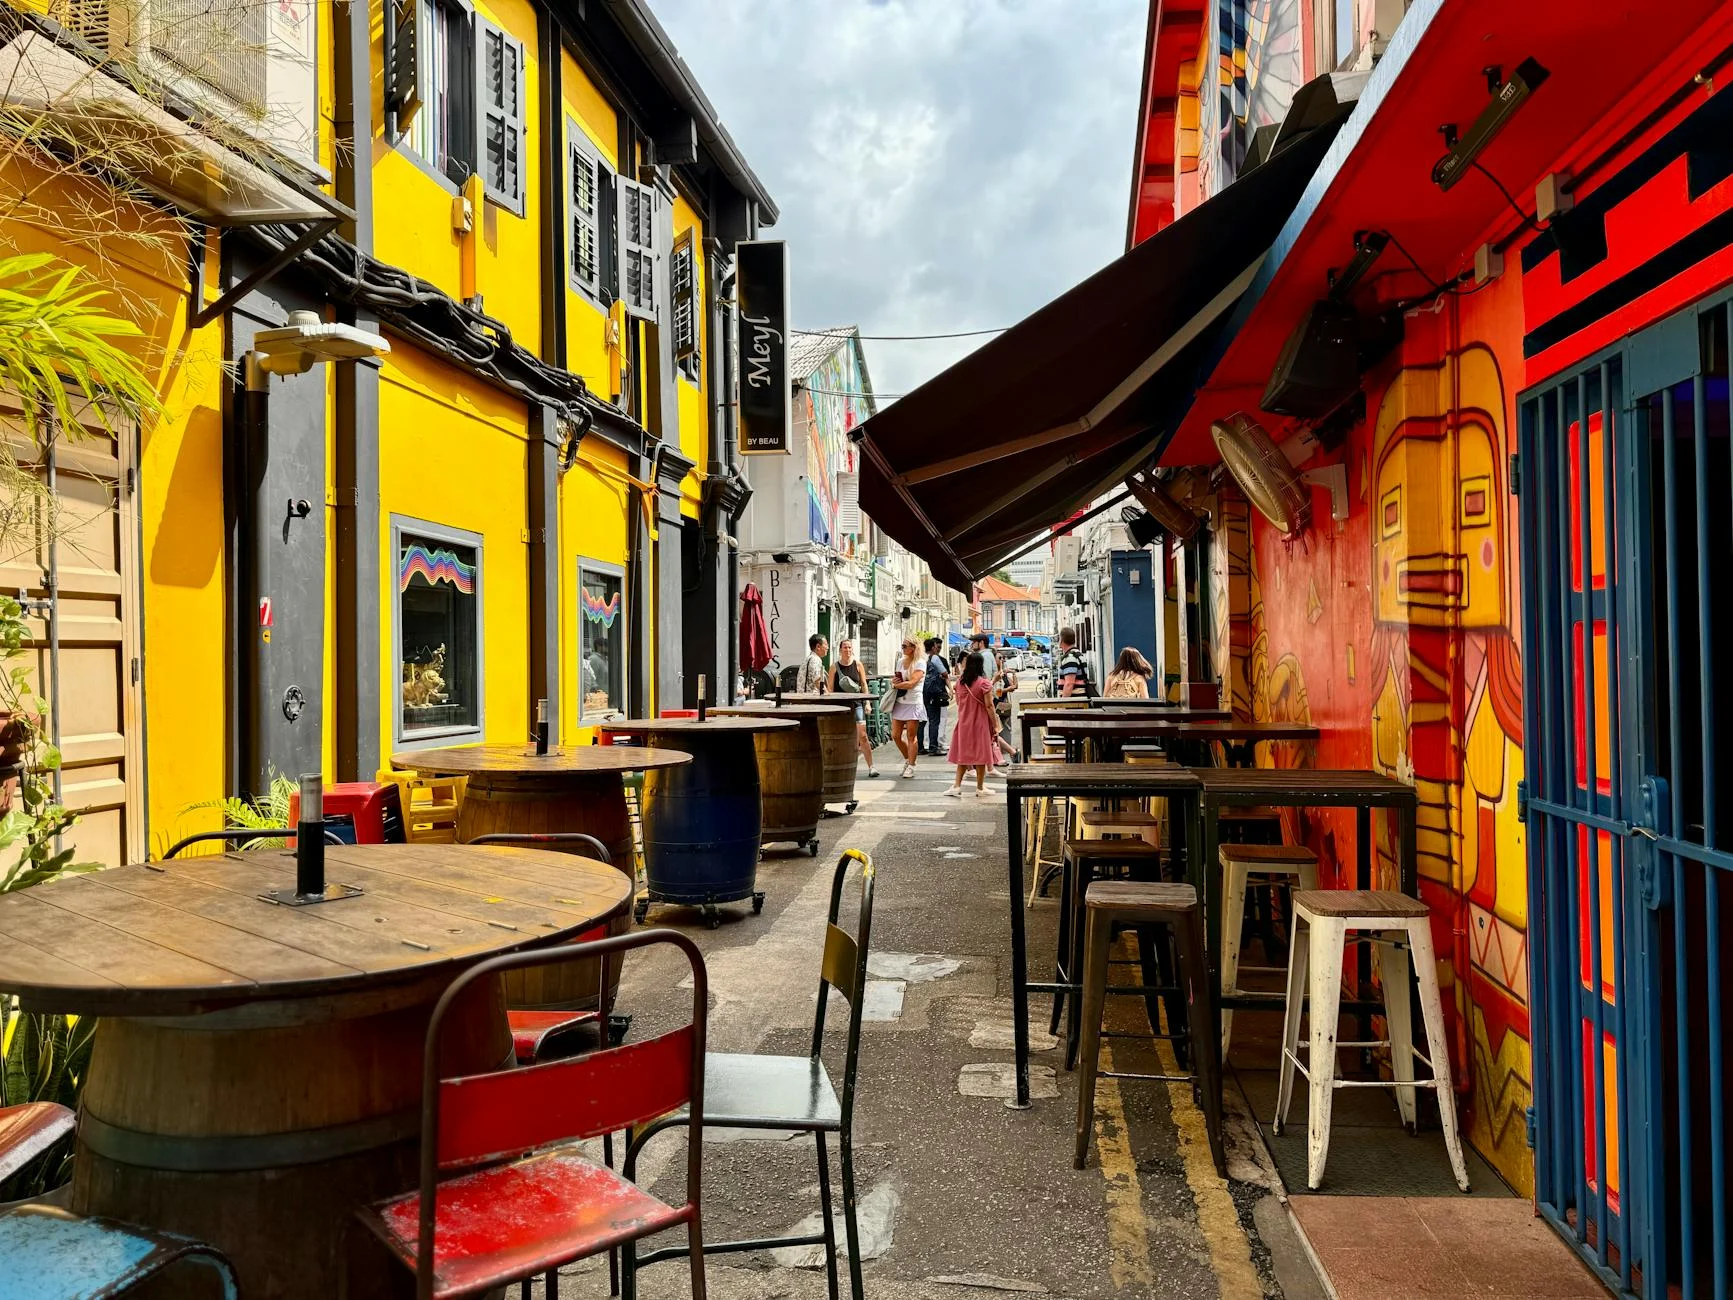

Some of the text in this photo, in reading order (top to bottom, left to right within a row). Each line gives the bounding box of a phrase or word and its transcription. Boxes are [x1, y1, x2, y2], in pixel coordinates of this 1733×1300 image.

[741, 310, 783, 387] Meyl
[748, 437, 779, 445] BY BEAU
[770, 570, 780, 669] BLACKS
